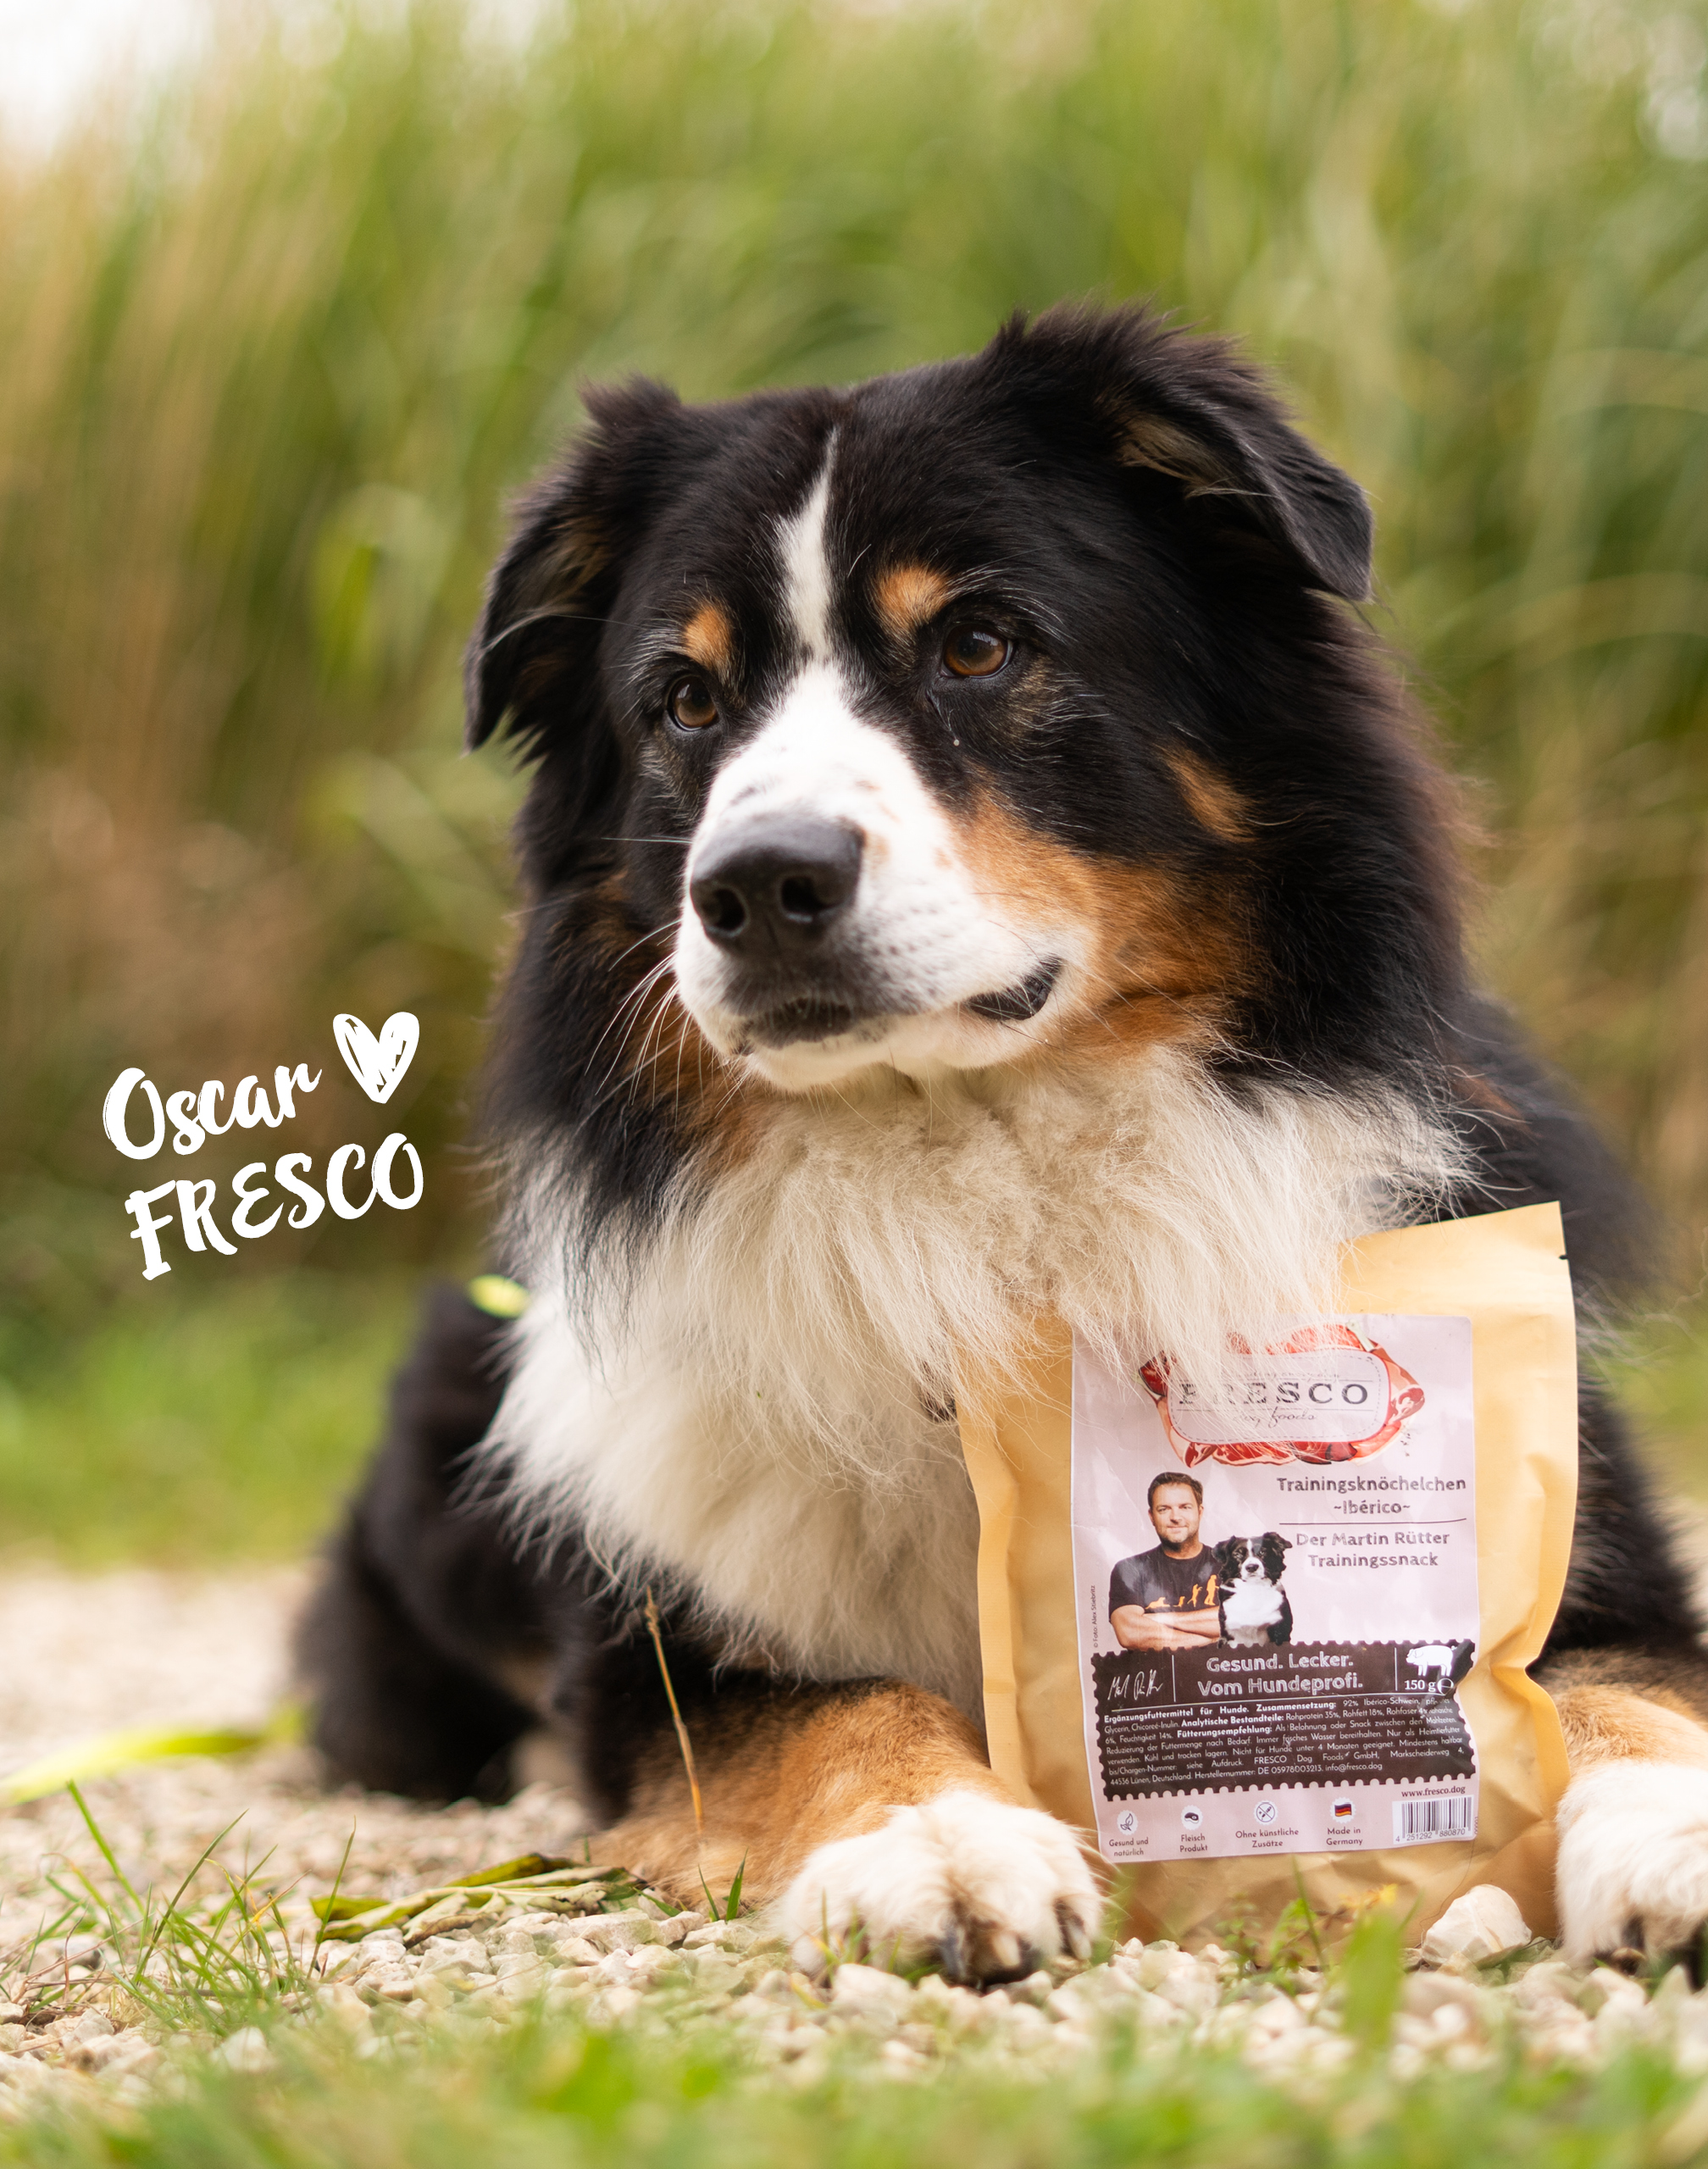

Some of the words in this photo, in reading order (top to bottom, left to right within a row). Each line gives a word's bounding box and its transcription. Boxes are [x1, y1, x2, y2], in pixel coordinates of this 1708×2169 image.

[1267, 1406, 1317, 1428] foods
[1277, 1476, 1467, 1495] Trainingsknöchelchen
[1296, 1533, 1327, 1546] Der
[1332, 1531, 1389, 1546] Martin
[1395, 1532, 1450, 1545] Rütter
[1308, 1552, 1439, 1568] Trainingssnack
[1206, 1653, 1284, 1673] Gesund.
[1289, 1650, 1354, 1668] Lecker.
[1197, 1680, 1243, 1696] Vom
[1248, 1673, 1363, 1695] Hundeprofi.
[1405, 1679, 1425, 1690] 150
[1428, 1681, 1436, 1692] g
[1104, 1707, 1193, 1724] Ergänzungsfuttermittel
[1200, 1707, 1212, 1716] für
[1220, 1705, 1249, 1714] Hunde.
[1256, 1701, 1336, 1712] Zusammensetzung:
[1104, 1726, 1130, 1735] Glycerin,
[1181, 1716, 1228, 1728] Analytische
[1230, 1712, 1284, 1724] Bestandteile:
[1286, 1712, 1323, 1721] Rohprotein
[1343, 1708, 1367, 1717] Rohfett
[1386, 1706, 1417, 1715] Rohfaser
[1119, 1733, 1156, 1743] Feuchtigkeit
[1177, 1725, 1273, 1739] Fütterungsempfehlung:
[1289, 1722, 1327, 1731] Belohnung
[1330, 1721, 1346, 1729] oder
[1350, 1719, 1372, 1728] Snack
[1374, 1718, 1406, 1727] zwischen
[1106, 1745, 1144, 1755] Reduzierung
[1161, 1741, 1202, 1750] Futtermenge
[1256, 1735, 1279, 1744] Immer
[1405, 1728, 1415, 1736] als
[1419, 1727, 1460, 1735] Heimtierfutter
[1144, 1753, 1159, 1761] Kühl
[1178, 1750, 1201, 1759] trocken
[1205, 1750, 1228, 1758] lagern.
[1327, 1742, 1359, 1750] Monaten
[1399, 1738, 1438, 1746] Mindestens
[1441, 1735, 1462, 1745] haltbar
[1254, 1756, 1287, 1764] FRESCO
[1297, 1754, 1312, 1763] Dog
[1390, 1748, 1450, 1758] Markscheiderweg
[1110, 1777, 1129, 1786] 44536
[1195, 1767, 1256, 1779] Herstellernummer:
[1258, 1767, 1270, 1775] DE
[1325, 1761, 1383, 1772] info@fresco.dog
[1401, 1785, 1466, 1798] www.fresco.dog
[1180, 1833, 1206, 1842] Fleisch
[1235, 1829, 1257, 1839] Ohne
[1259, 1828, 1299, 1837] künstliche
[1327, 1827, 1351, 1835] Made
[1406, 1832, 1433, 1841] 251292
[1439, 1828, 1466, 1837] 880870
[1109, 1838, 1134, 1847] Gesund
[1136, 1837, 1149, 1845] und
[1179, 1844, 1208, 1853] Produkt
[1252, 1839, 1284, 1849] Zusätze
[1326, 1837, 1363, 1846] Germany
[1113, 1849, 1144, 1857] natürlich
